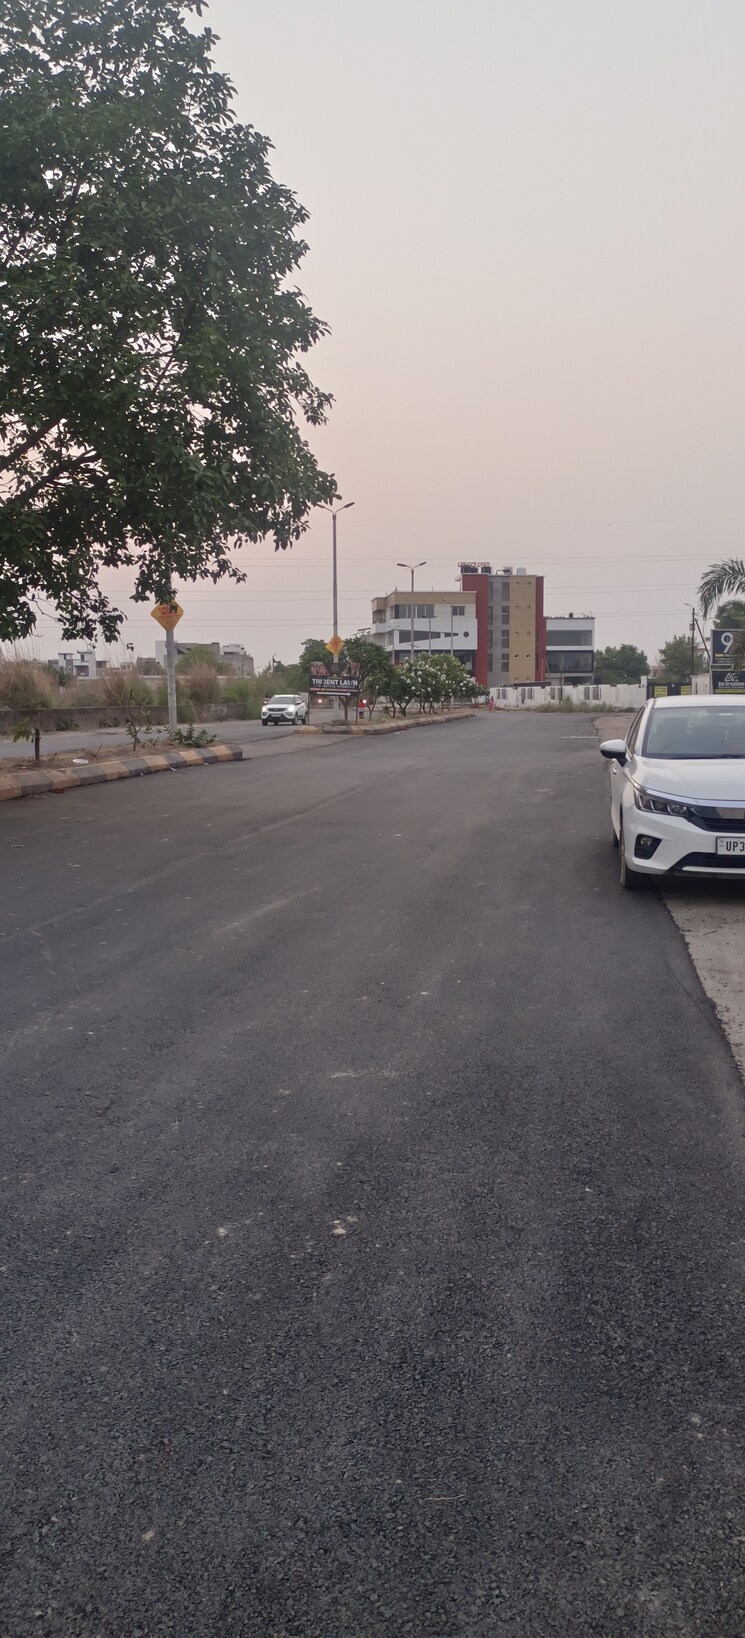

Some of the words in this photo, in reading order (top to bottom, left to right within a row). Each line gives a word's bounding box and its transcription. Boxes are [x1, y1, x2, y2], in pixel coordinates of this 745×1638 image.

[312, 678, 339, 686] TRIDENT
[340, 679, 358, 687] LAWN
[726, 841, 745, 852] UP3
